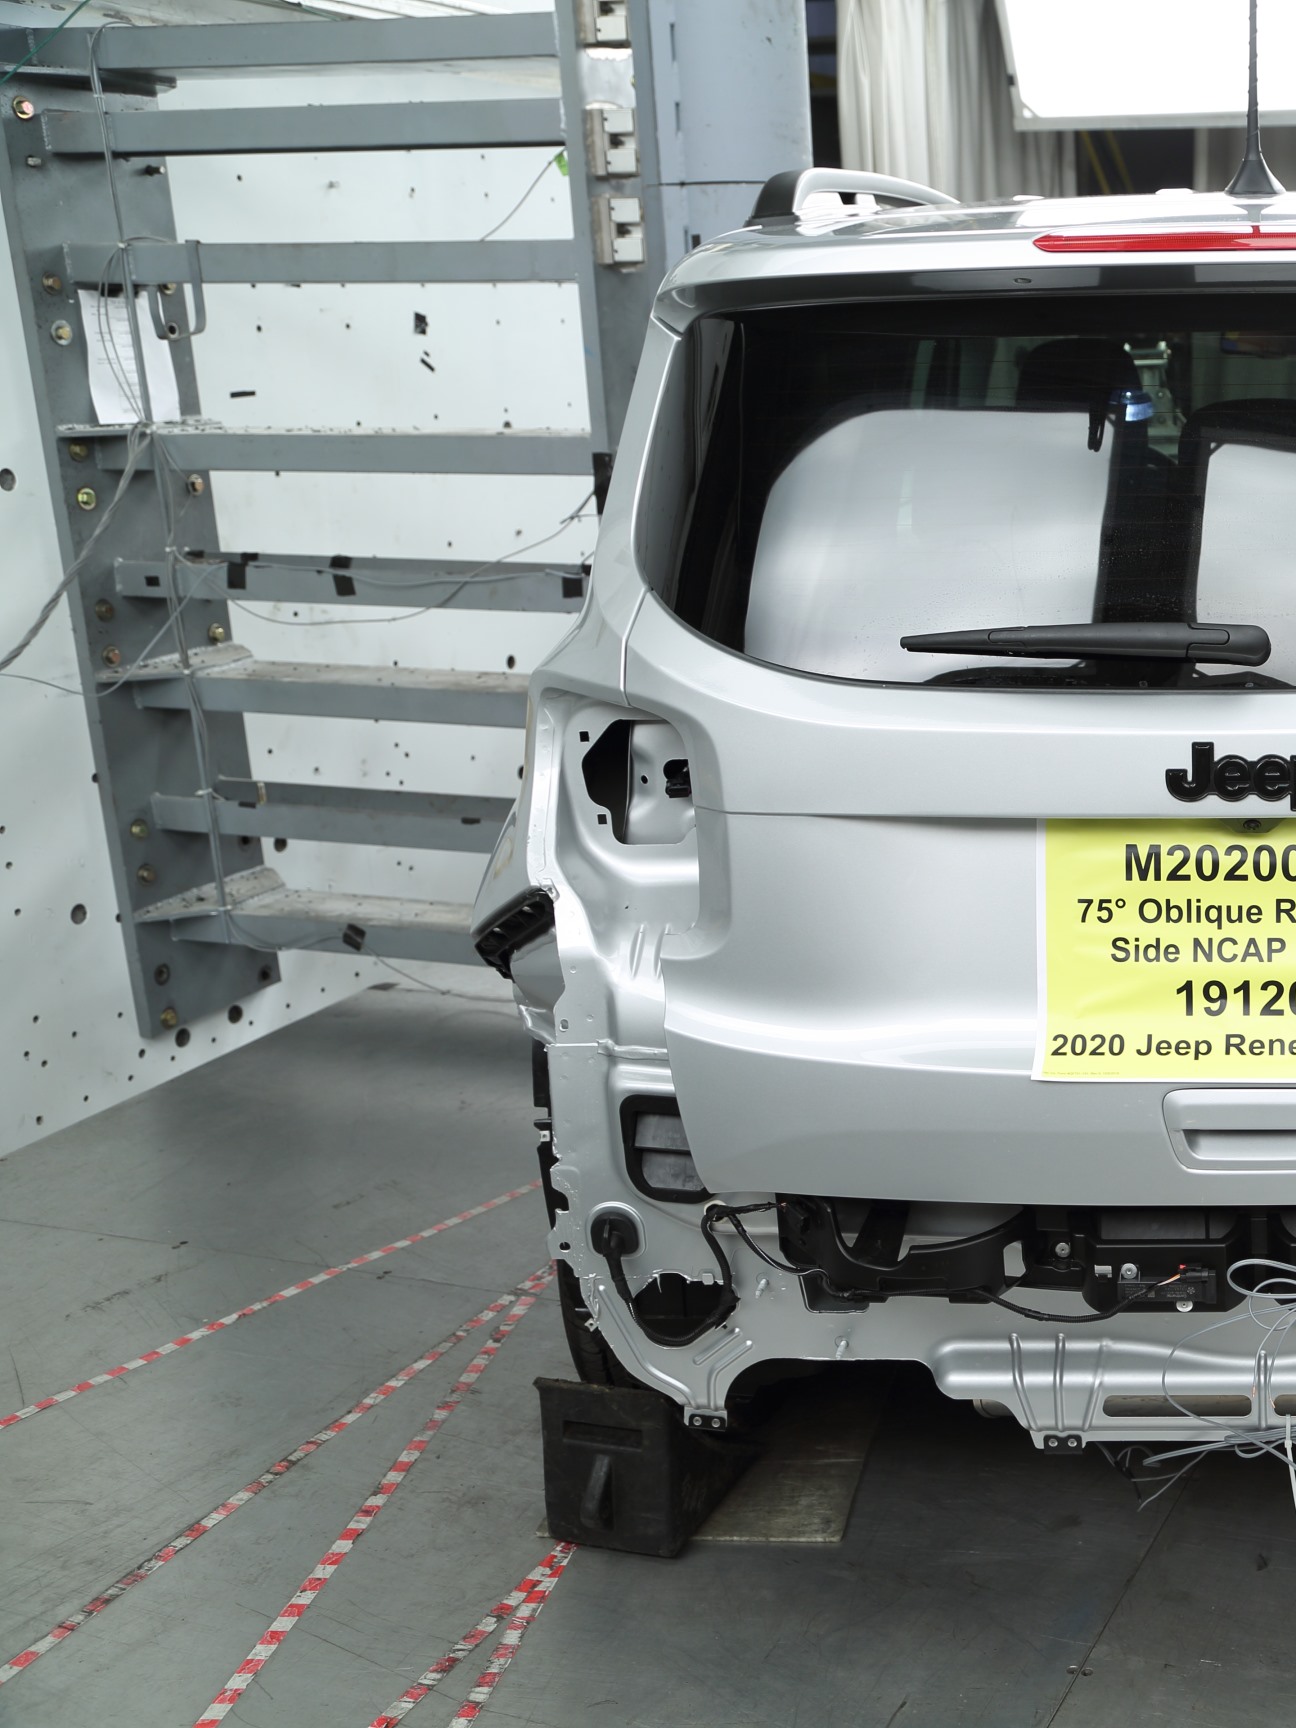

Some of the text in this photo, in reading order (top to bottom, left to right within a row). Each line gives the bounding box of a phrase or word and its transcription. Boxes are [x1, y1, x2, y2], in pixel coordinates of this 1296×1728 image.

[1138, 897, 1263, 930] Oblique
[1110, 936, 1180, 963] Side
[1192, 936, 1287, 963] NCAP
[1050, 1033, 1125, 1057] 2020
[1135, 1033, 1213, 1061] Jeep
